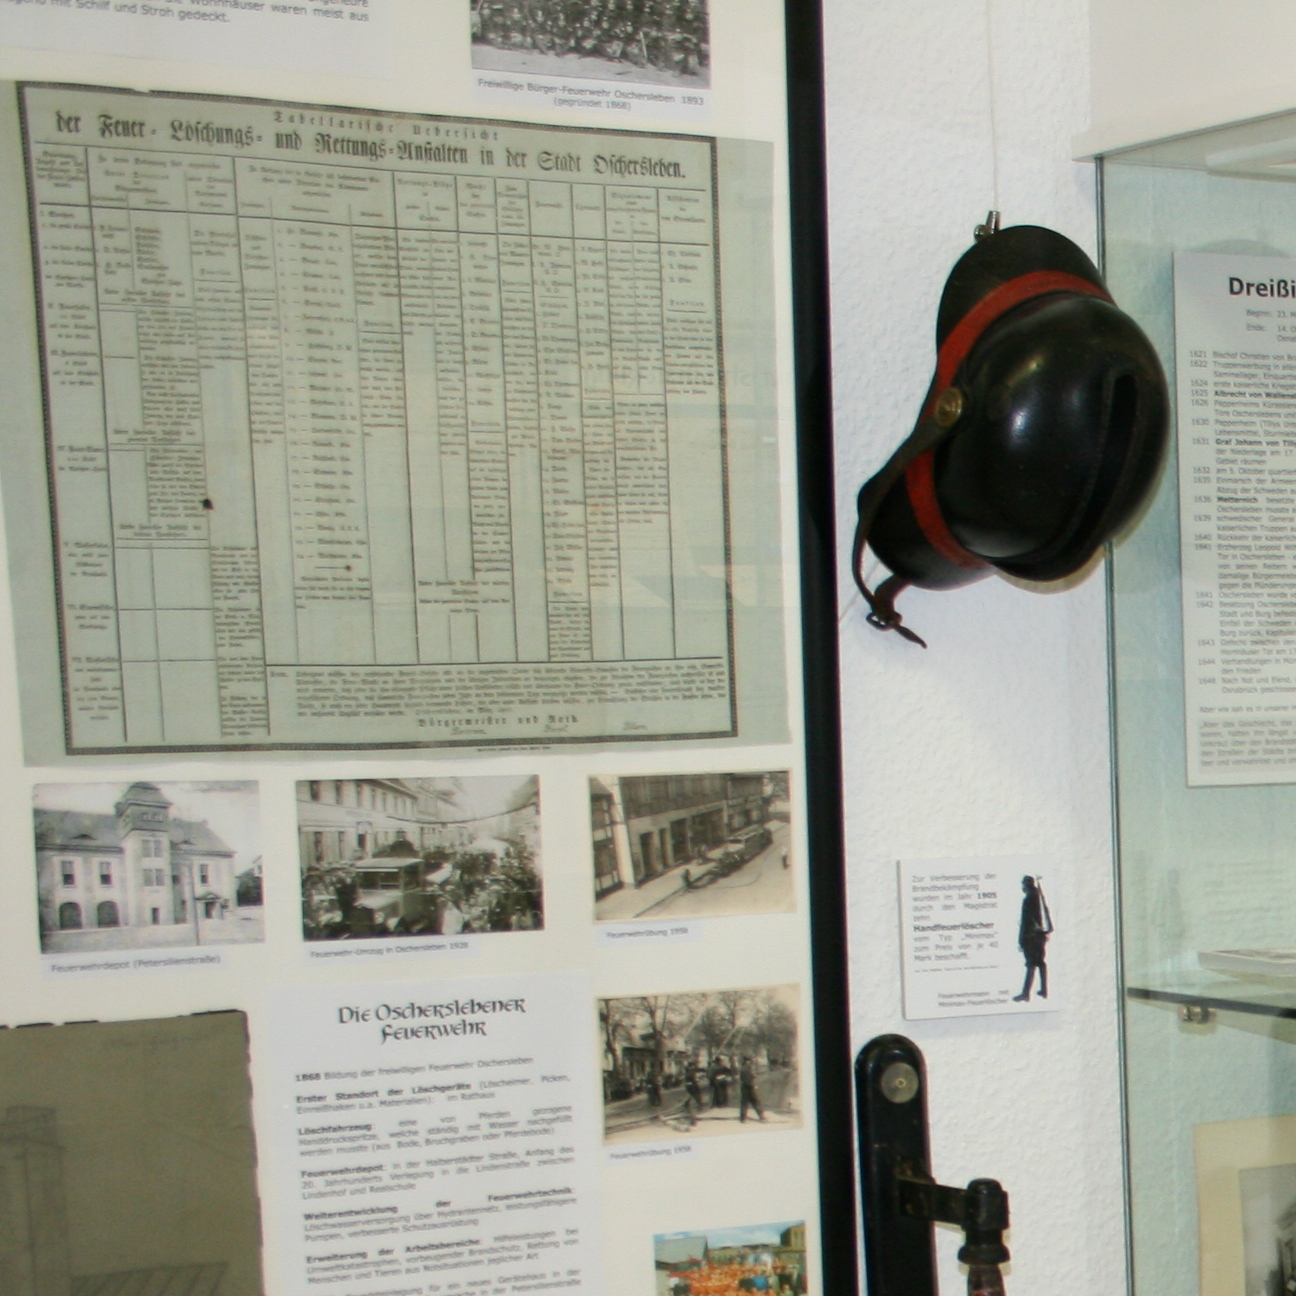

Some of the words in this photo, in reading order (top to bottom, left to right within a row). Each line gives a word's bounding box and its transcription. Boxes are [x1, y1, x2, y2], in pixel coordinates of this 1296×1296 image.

[115, 2, 137, 14] und
[142, 5, 174, 18] Stroh
[178, 10, 231, 23] gedeckt.
[271, 4, 307, 15] waren
[313, 8, 344, 19] meist
[350, 12, 369, 20] aus
[478, 78, 525, 91] Freiwillige
[615, 90, 675, 103] Oschersleben
[681, 96, 704, 106] 1893
[56, 110, 81, 134] der
[275, 132, 302, 151] und
[480, 146, 495, 166] in
[505, 148, 527, 169] der
[538, 155, 582, 173] Stadt
[517, 715, 539, 725] und
[913, 922, 994, 932] Handfeuerlöscher
[338, 1006, 371, 1024] Die
[375, 998, 527, 1022] Oscherslebener
[380, 1020, 488, 1044] Feuerwehr
[295, 1072, 322, 1082] 1868
[428, 1061, 474, 1073] Feuerwehr
[476, 1056, 534, 1069] Oschersleben
[296, 1093, 328, 1104] Erster
[335, 1089, 380, 1101] Standort
[388, 1088, 404, 1097] der
